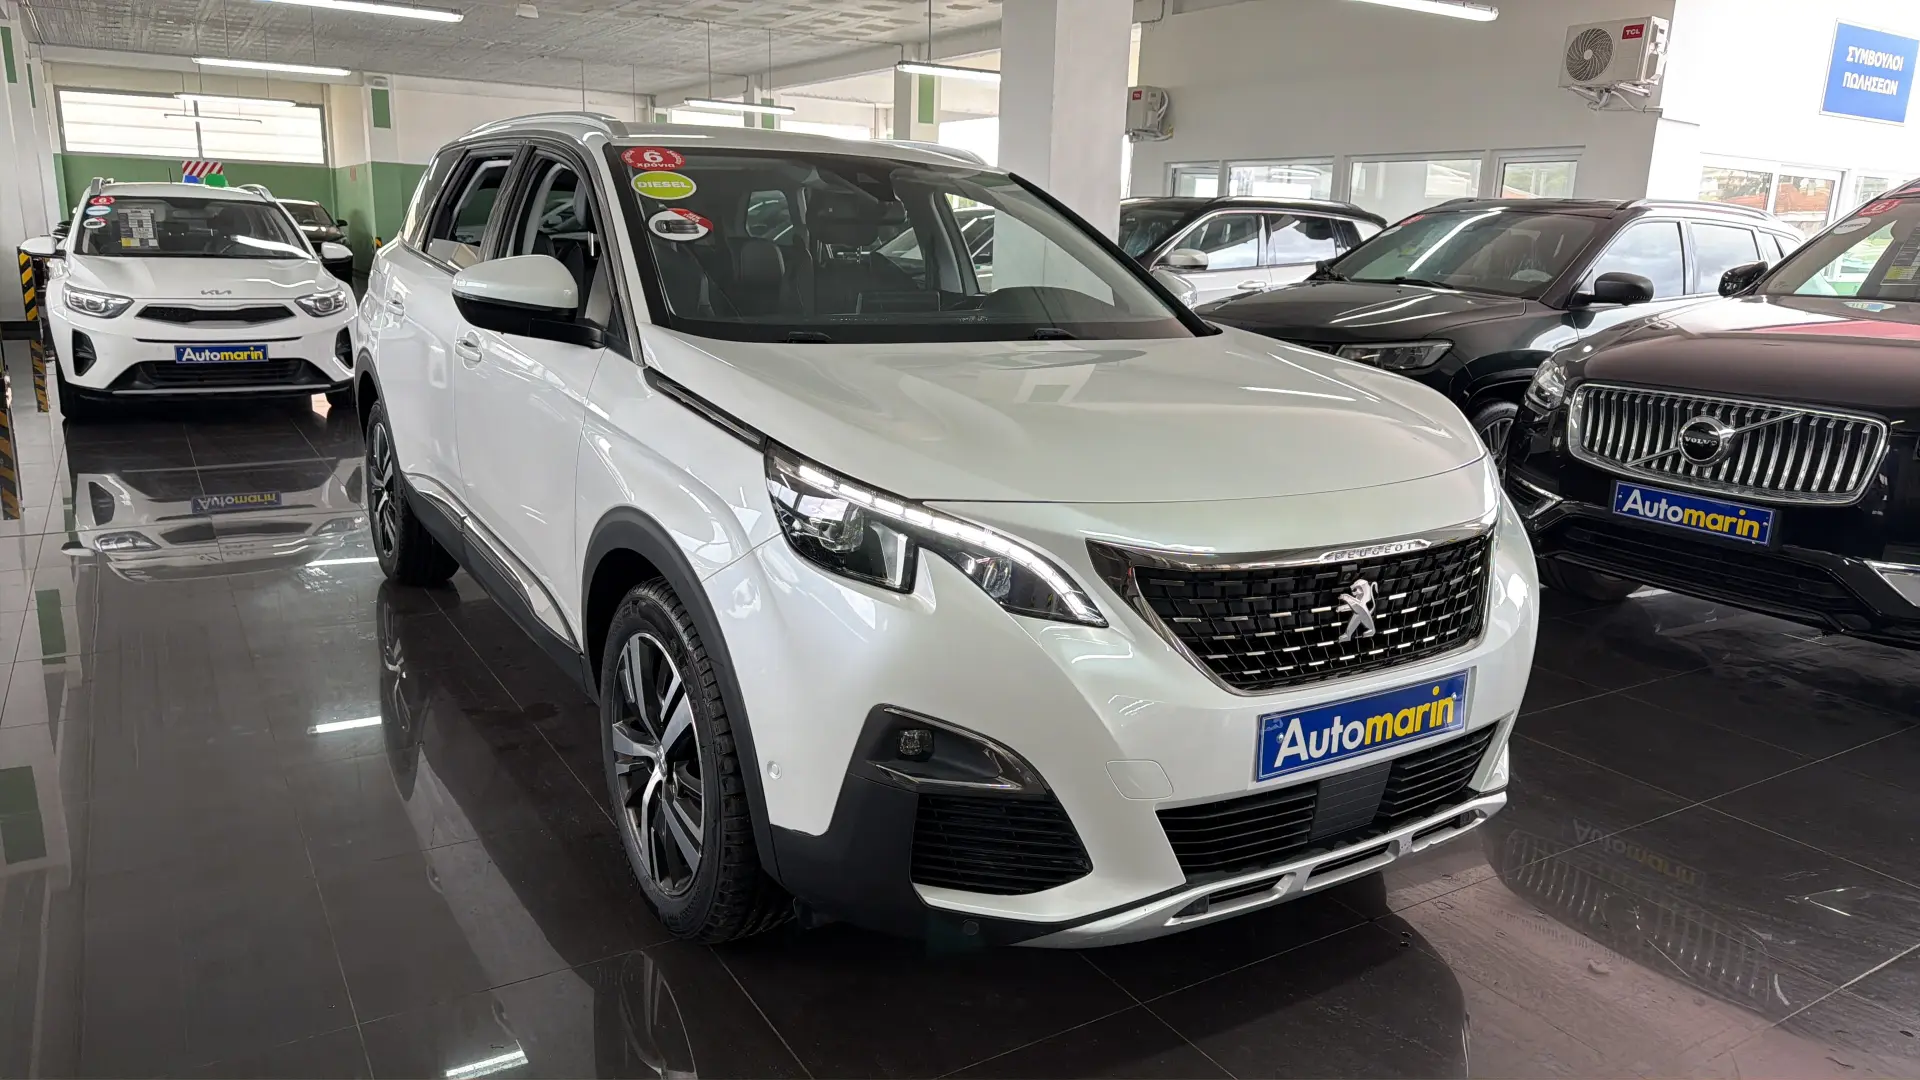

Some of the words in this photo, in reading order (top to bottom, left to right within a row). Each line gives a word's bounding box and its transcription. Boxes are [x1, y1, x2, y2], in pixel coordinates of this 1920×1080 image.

[1846, 46, 1904, 71] ΣΥΜΒΟΥΛΟΙ
[1842, 72, 1899, 95] ΠΩΛΗΣΕΩΝ
[643, 151, 664, 163] 6
[182, 346, 263, 361] Automarin
[1684, 436, 1718, 447] VOLVO
[1622, 489, 1760, 539] Automarin
[1334, 543, 1412, 561] PEUGEOT
[1274, 686, 1454, 767] Automarin
